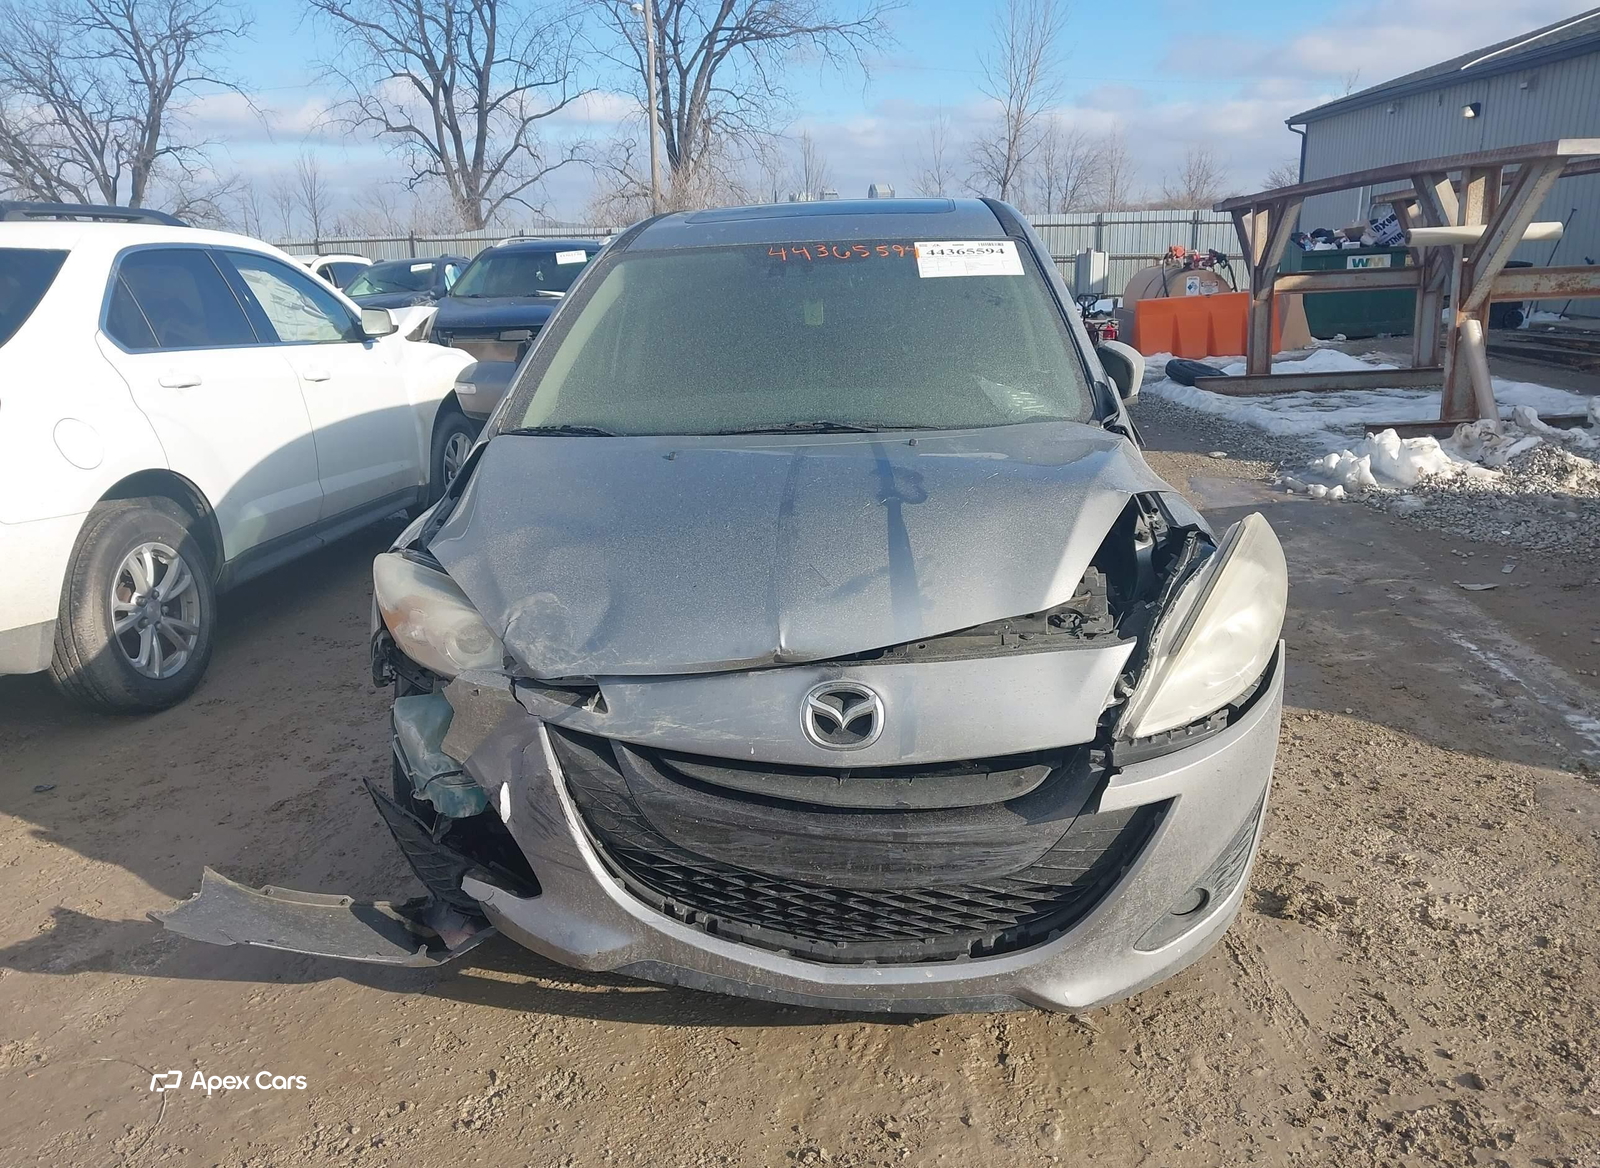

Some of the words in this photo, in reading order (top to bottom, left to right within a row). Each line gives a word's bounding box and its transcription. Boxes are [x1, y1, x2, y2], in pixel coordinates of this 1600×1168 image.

[768, 244, 919, 260] 44365594
[926, 248, 1005, 256] 44365594
[1352, 257, 1385, 268] WM
